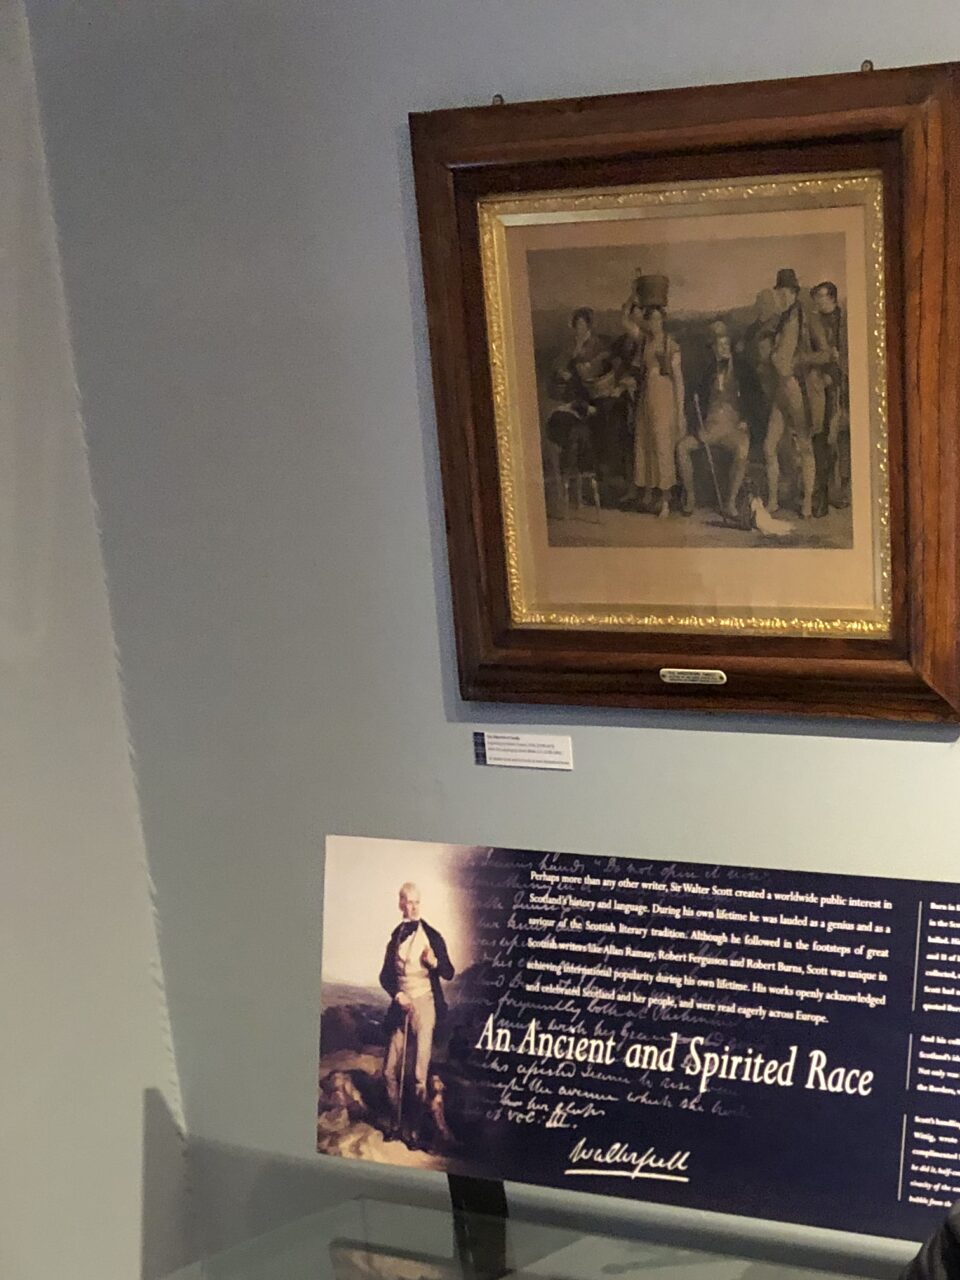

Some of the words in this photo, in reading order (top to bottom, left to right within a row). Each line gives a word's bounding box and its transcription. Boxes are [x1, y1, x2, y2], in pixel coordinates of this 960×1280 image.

[530, 871, 560, 886] Perhaps
[561, 876, 582, 887] more
[584, 875, 601, 885] than
[602, 880, 616, 889] any
[617, 878, 639, 888] other
[641, 882, 669, 892] writer,
[670, 882, 682, 892] Sir
[682, 883, 710, 894] Walter
[711, 886, 733, 896] Scott
[734, 889, 765, 898] created
[774, 892, 819, 903] worldwide
[820, 895, 847, 907] public
[848, 898, 881, 908] interest
[883, 900, 893, 909] in
[597, 900, 612, 909] and
[613, 900, 650, 915] language.
[652, 904, 682, 918] During
[682, 906, 694, 916] his
[715, 909, 748, 921] lifetime
[749, 912, 759, 922] he
[779, 914, 808, 926] lauded
[826, 921, 855, 932] genius
[856, 922, 873, 931] and
[585, 921, 616, 932] Scottish
[618, 923, 648, 938] literary
[690, 931, 728, 945] Although
[730, 934, 741, 943] he
[744, 935, 781, 947] followed
[783, 940, 792, 948] in
[795, 940, 809, 950] the
[812, 941, 851, 957] footsteps
[853, 945, 865, 954] of
[866, 949, 889, 959] great
[625, 947, 657, 961] Ramsay,
[658, 950, 687, 961] Robert
[729, 958, 745, 967] and
[746, 959, 777, 970] Robert
[777, 962, 805, 974] Burns,
[806, 965, 828, 975] Scott
[847, 970, 877, 983] unique
[878, 972, 888, 981] in
[525, 983, 540, 991] and
[616, 992, 632, 1001] and
[632, 993, 647, 1003] her
[647, 996, 678, 1009] people,
[678, 999, 695, 1008] and
[717, 1003, 736, 1013] read
[737, 1006, 768, 1019] eagerly
[768, 1011, 794, 1019] across
[795, 1011, 830, 1025] Europe.
[613, 970, 654, 984] popularity
[655, 973, 683, 987] during
[683, 975, 696, 985] his
[716, 979, 751, 991] lifetime.
[752, 983, 767, 992] His
[768, 985, 794, 995] works
[795, 989, 823, 1002] openly
[825, 990, 886, 1007] acknowledged
[475, 1013, 512, 1051] An
[518, 1018, 615, 1066] Ancient
[625, 1032, 678, 1073] and
[685, 1037, 799, 1094] Spirited
[805, 1050, 874, 1096] Race
